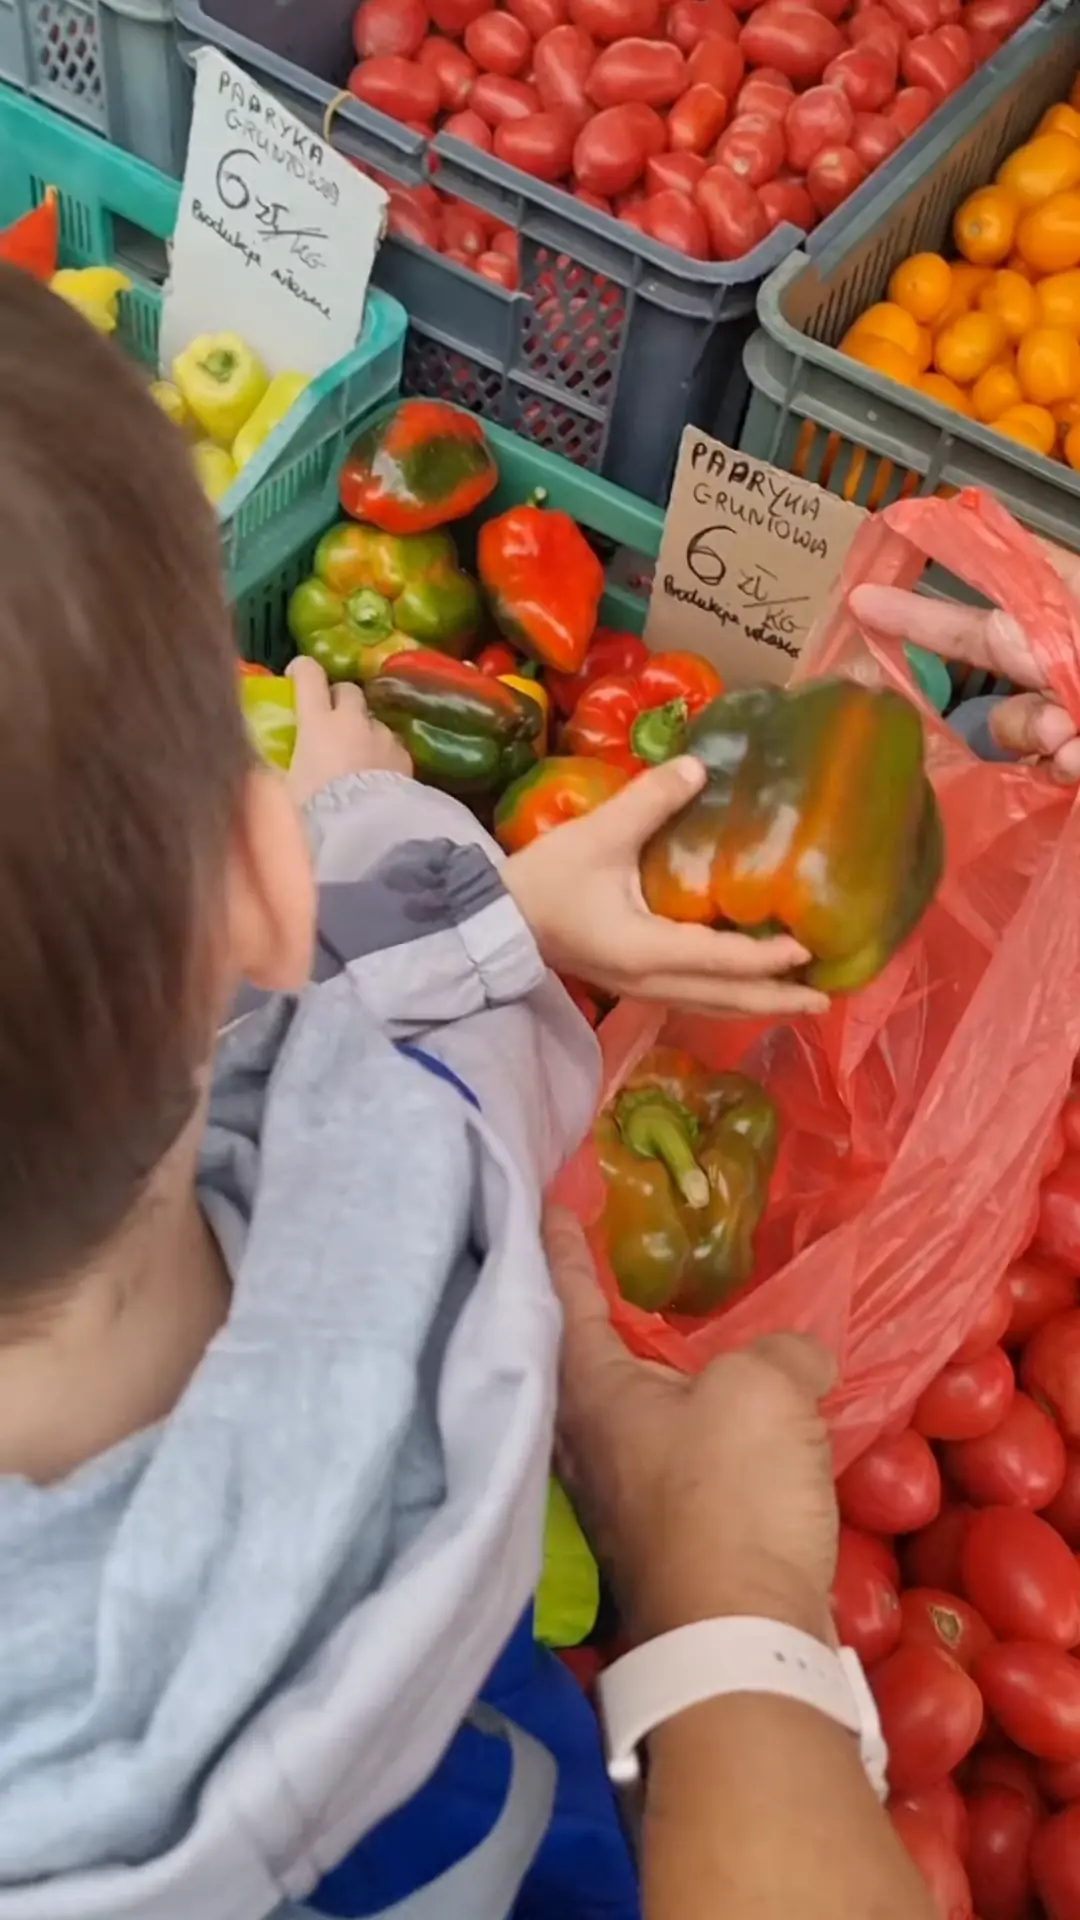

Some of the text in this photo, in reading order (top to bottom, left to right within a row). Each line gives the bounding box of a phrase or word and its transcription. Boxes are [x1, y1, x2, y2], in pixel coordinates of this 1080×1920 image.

[216, 148, 261, 210] 6
[691, 442, 820, 520] PAPRYKA
[693, 482, 828, 558] GRUNTOWA
[686, 525, 737, 586] 6
